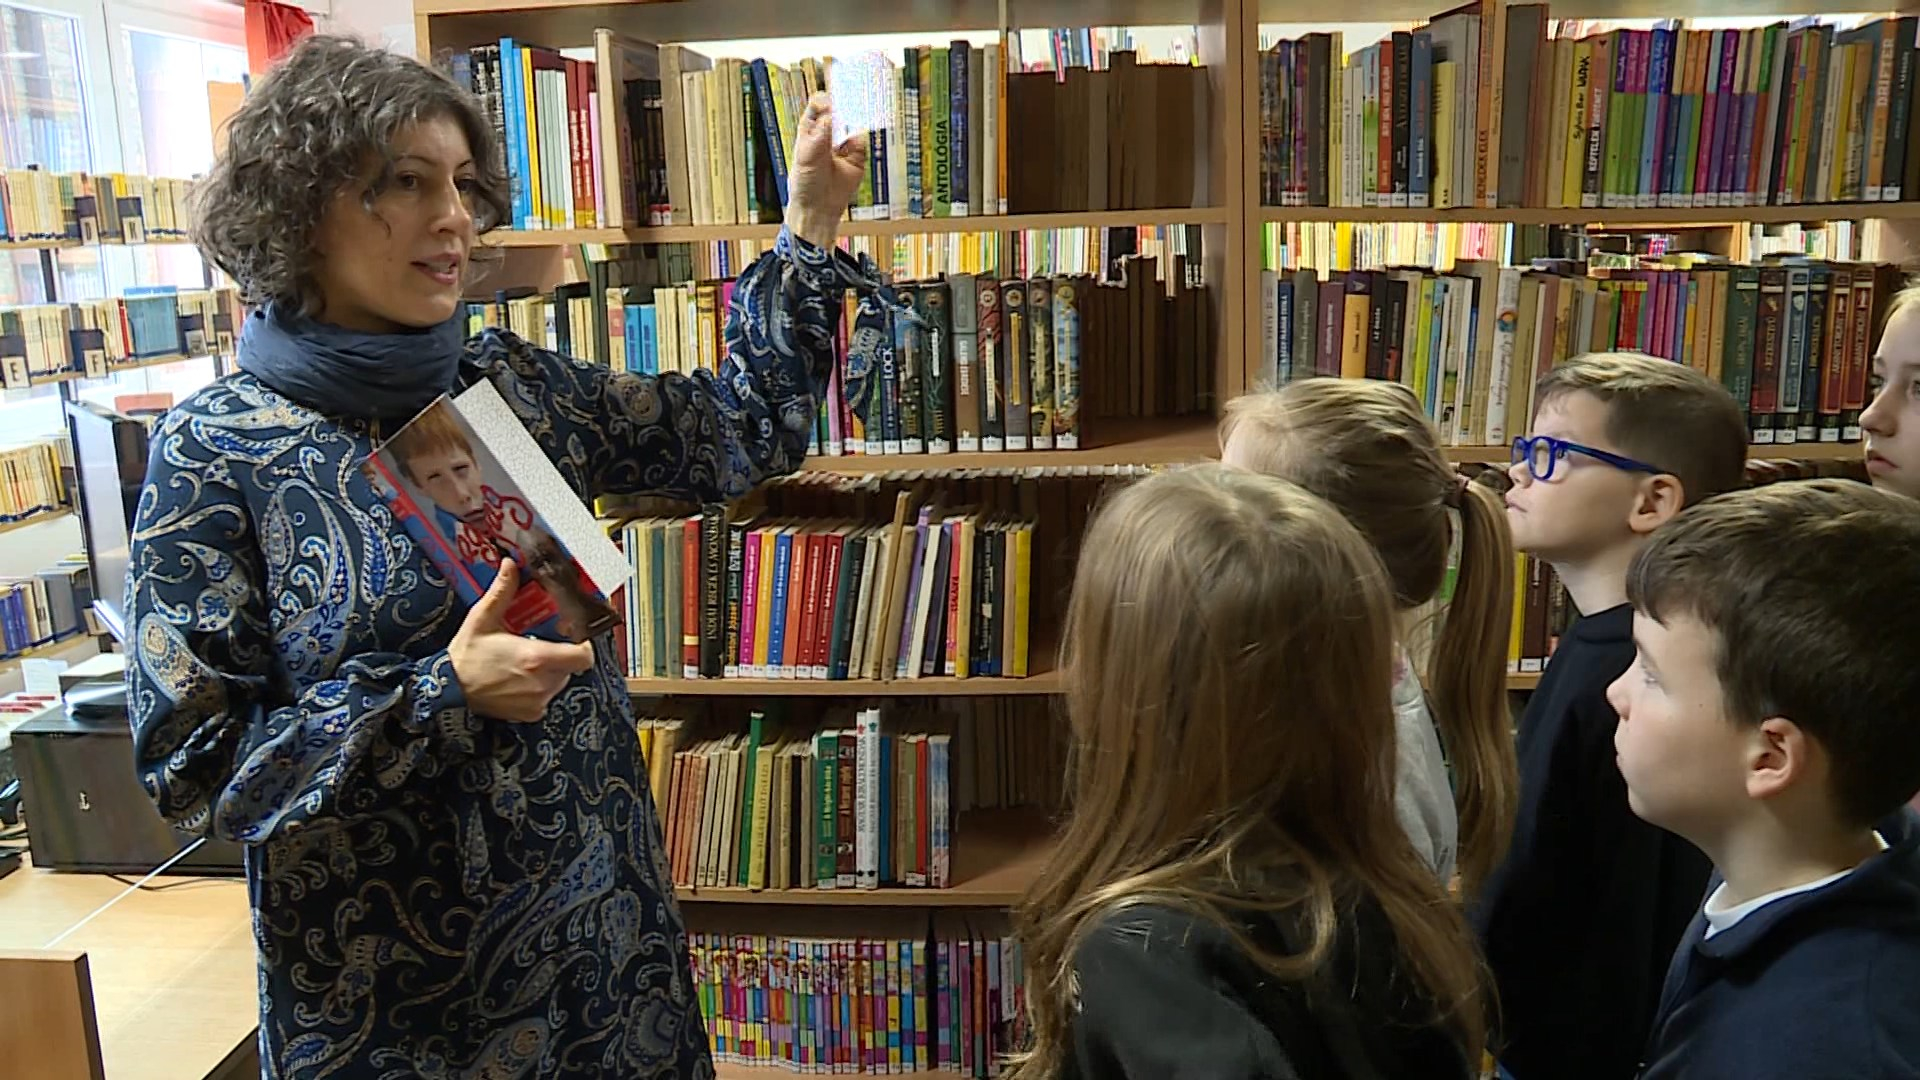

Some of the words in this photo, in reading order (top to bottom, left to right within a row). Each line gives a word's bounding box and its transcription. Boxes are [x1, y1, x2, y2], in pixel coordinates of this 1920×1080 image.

[1877, 38, 1894, 107] DRIFTER
[935, 119, 949, 204] ANTOLÓGIA
[707, 575, 718, 605] REGÉK
[706, 608, 717, 640] INDIAI
